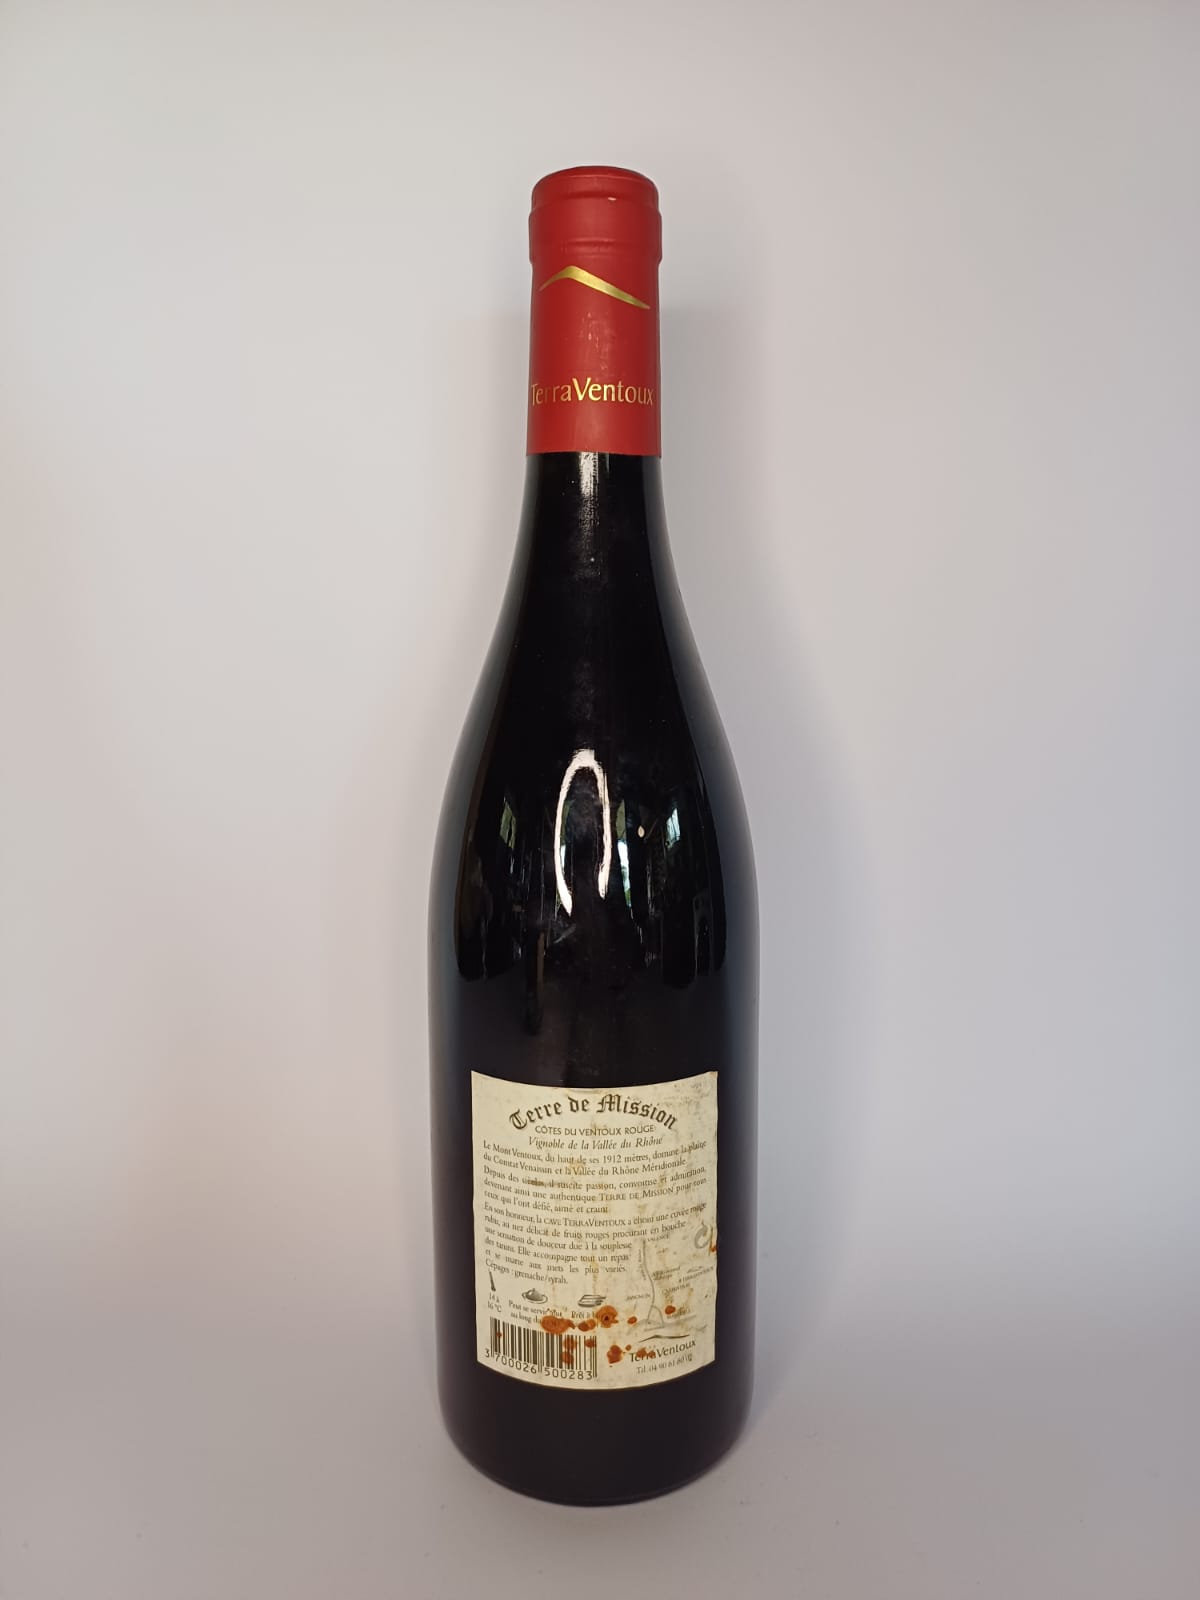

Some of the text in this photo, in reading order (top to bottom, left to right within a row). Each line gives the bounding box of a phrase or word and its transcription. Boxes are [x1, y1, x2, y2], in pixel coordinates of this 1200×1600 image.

[531, 377, 655, 406] TerraVentoux
[509, 1094, 677, 1129] Terre de Mission
[535, 1125, 561, 1135] CÔTES
[579, 1127, 621, 1136] VENTOUX
[625, 1125, 654, 1134] ROUGE
[483, 1140, 491, 1149] Le
[493, 1143, 511, 1154] Mont
[545, 1153, 554, 1162] du
[557, 1154, 573, 1163] haut
[577, 1155, 586, 1164] de
[624, 1153, 650, 1163] mètres,
[529, 1136, 662, 1150] Vignoble de la Vallée du Rhône
[484, 1153, 491, 1161] du
[493, 1155, 518, 1168] Comtat
[520, 1162, 552, 1174] Venaissin
[555, 1166, 561, 1174] et
[565, 1167, 571, 1175] la
[573, 1166, 596, 1175] Vallée
[599, 1166, 608, 1175] du
[612, 1164, 639, 1175] Rhône
[484, 1165, 506, 1181] Depuis
[508, 1173, 519, 1182] des
[557, 1181, 583, 1189] suscite
[586, 1180, 616, 1192] passion,
[620, 1178, 657, 1188] convoitise
[484, 1178, 512, 1192] devenant
[514, 1187, 530, 1196] ainsi
[550, 1192, 596, 1204] authentique
[629, 1192, 639, 1200] DE
[676, 1182, 691, 1193] pour
[693, 1178, 707, 1186] tous
[484, 1190, 499, 1200] ceux
[500, 1195, 512, 1204] qui
[533, 1201, 552, 1212] défié,
[554, 1204, 573, 1212] aimé
[483, 1201, 492, 1212] En
[494, 1207, 504, 1216] son
[536, 1215, 542, 1223] la
[656, 1213, 669, 1221] une
[484, 1226, 495, 1235] une
[498, 1230, 524, 1243] sensation
[526, 1236, 534, 1246] de
[537, 1236, 566, 1249] douceur
[569, 1242, 582, 1250] due
[502, 1220, 509, 1228] au
[512, 1223, 523, 1231] nez
[526, 1223, 549, 1236] délicat
[552, 1228, 560, 1237] de
[564, 1229, 583, 1239] fruits
[586, 1232, 610, 1240] rouges
[612, 1227, 647, 1240] procurant
[650, 1225, 659, 1234] en
[662, 1221, 687, 1232] bouche
[485, 1237, 494, 1246] des
[518, 1246, 531, 1256] Elle
[533, 1251, 577, 1263] accompagne
[486, 1258, 509, 1274] Cépages
[506, 1256, 524, 1266] marie
[529, 1261, 541, 1269] aux
[547, 1263, 563, 1272] mets
[570, 1264, 579, 1272] les
[585, 1266, 599, 1275] plus
[509, 1300, 521, 1310] Peut
[519, 1312, 532, 1323] long
[485, 1349, 592, 1380] 3 700026 500283
